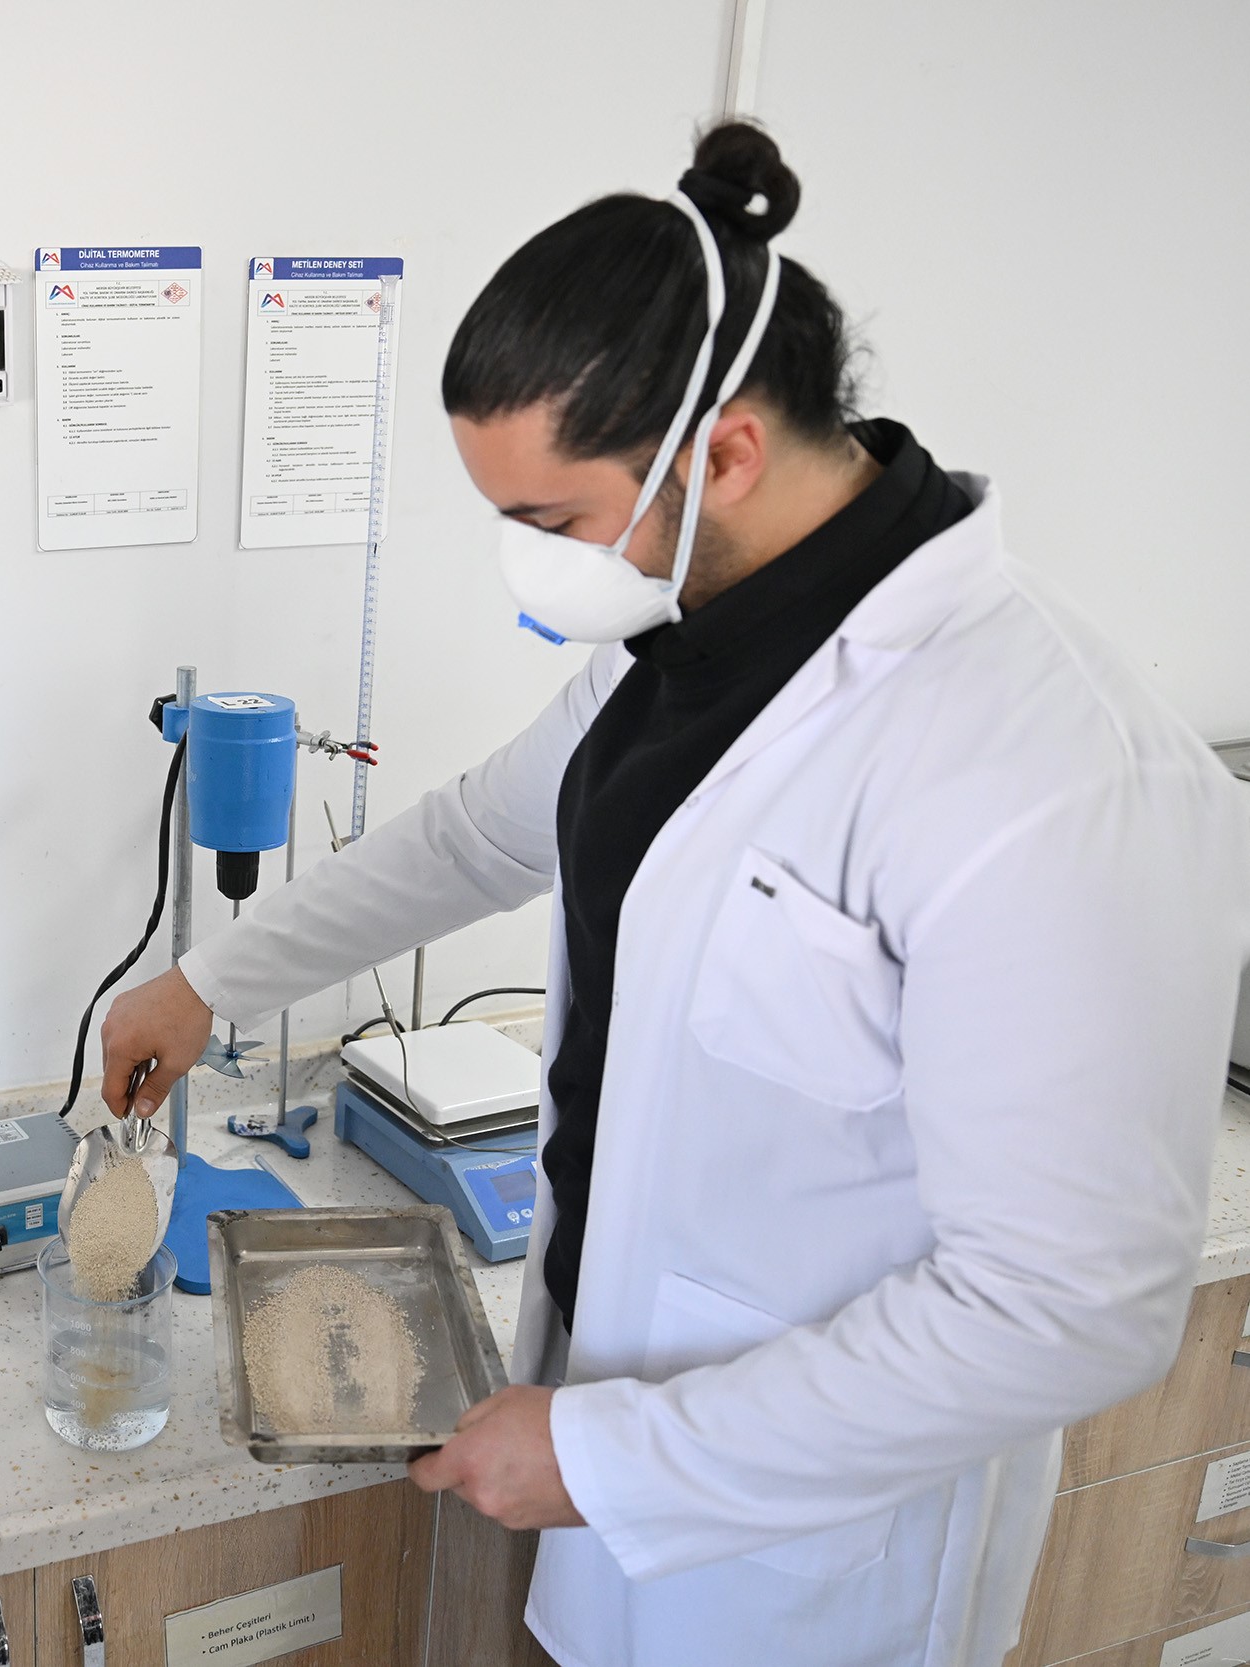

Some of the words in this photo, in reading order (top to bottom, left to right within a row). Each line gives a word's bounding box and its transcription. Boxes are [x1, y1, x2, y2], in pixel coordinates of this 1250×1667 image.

[79, 249, 106, 258] DİJİTAL
[108, 250, 159, 258] TERMOMETRE
[292, 259, 322, 268] METİLEN
[348, 259, 363, 268] SETİ
[70, 1320, 92, 1332] 1000
[70, 1346, 86, 1358] 800
[70, 1373, 86, 1384] 600
[208, 1626, 234, 1639] Beher
[236, 1613, 271, 1631] Çeşitleri
[209, 1643, 228, 1654] Cam
[230, 1635, 254, 1647] Plaka
[256, 1623, 287, 1639] (Plastik
[288, 1616, 310, 1627] Limit
